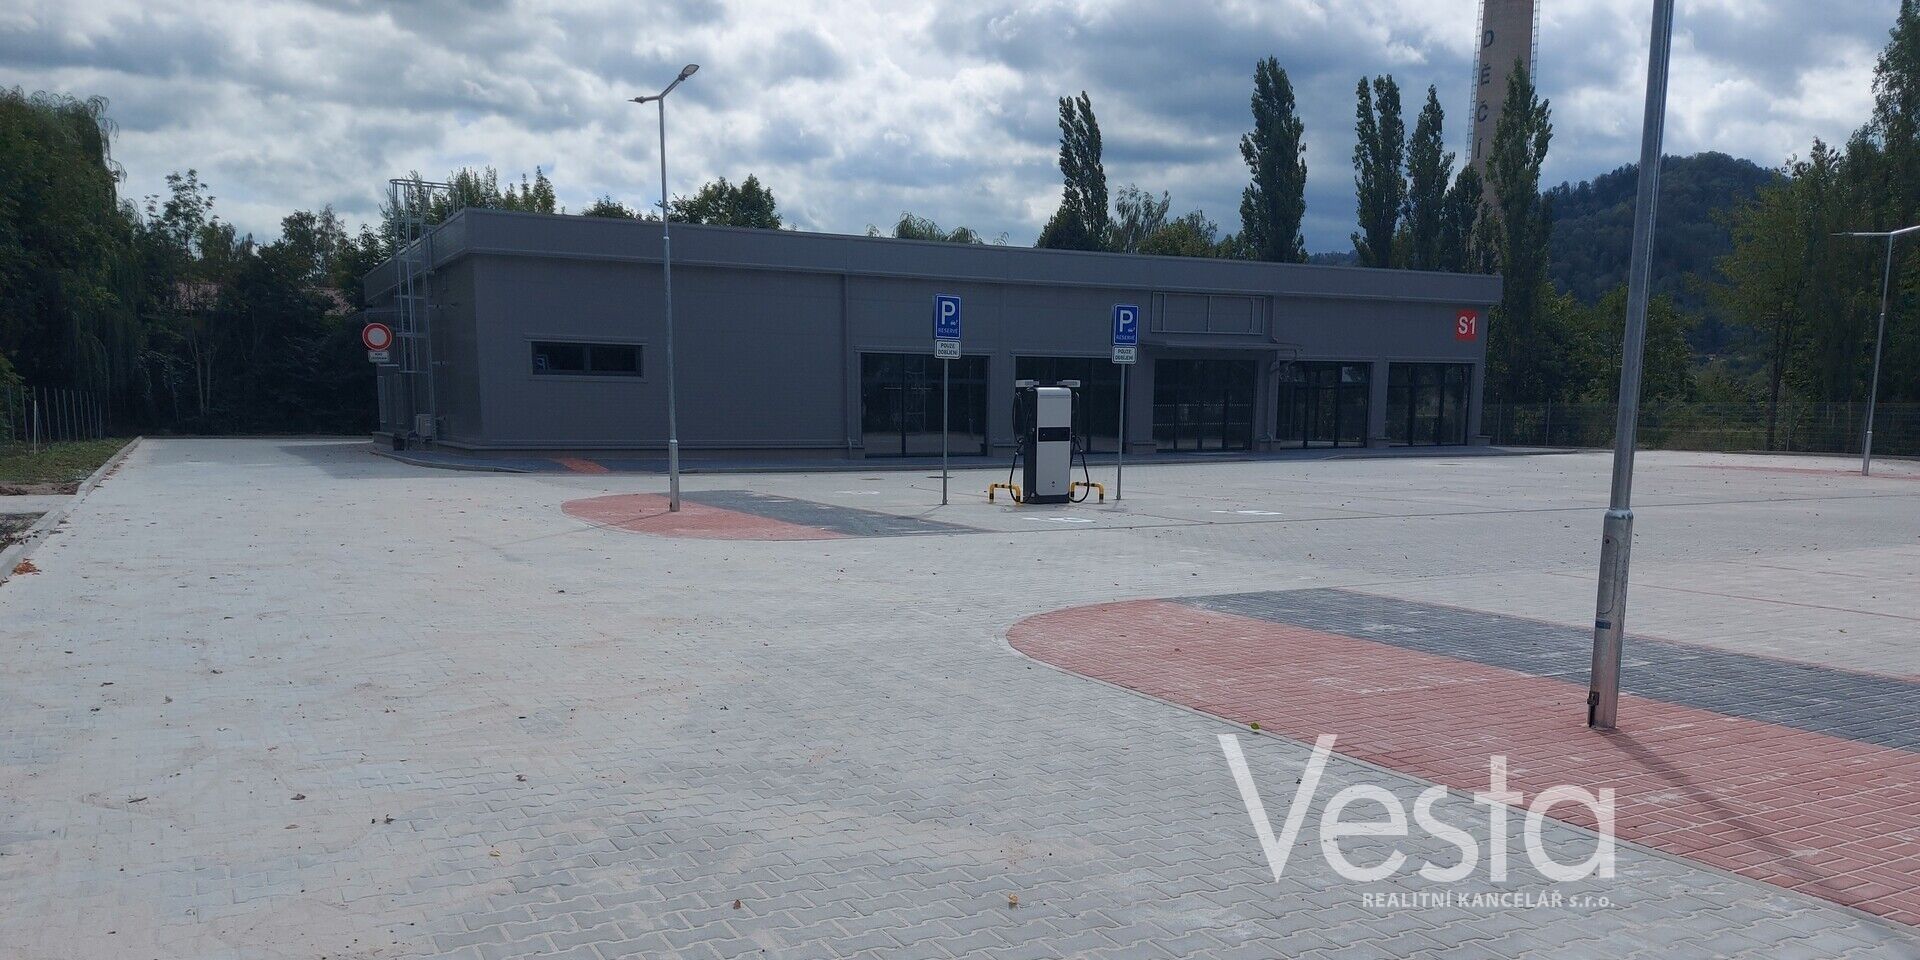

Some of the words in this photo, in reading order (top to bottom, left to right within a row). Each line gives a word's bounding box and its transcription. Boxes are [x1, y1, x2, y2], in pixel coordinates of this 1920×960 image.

[1477, 29, 1495, 160] DĚČÍ
[941, 300, 956, 325] P
[1120, 309, 1133, 332] P
[1458, 316, 1476, 335] S1
